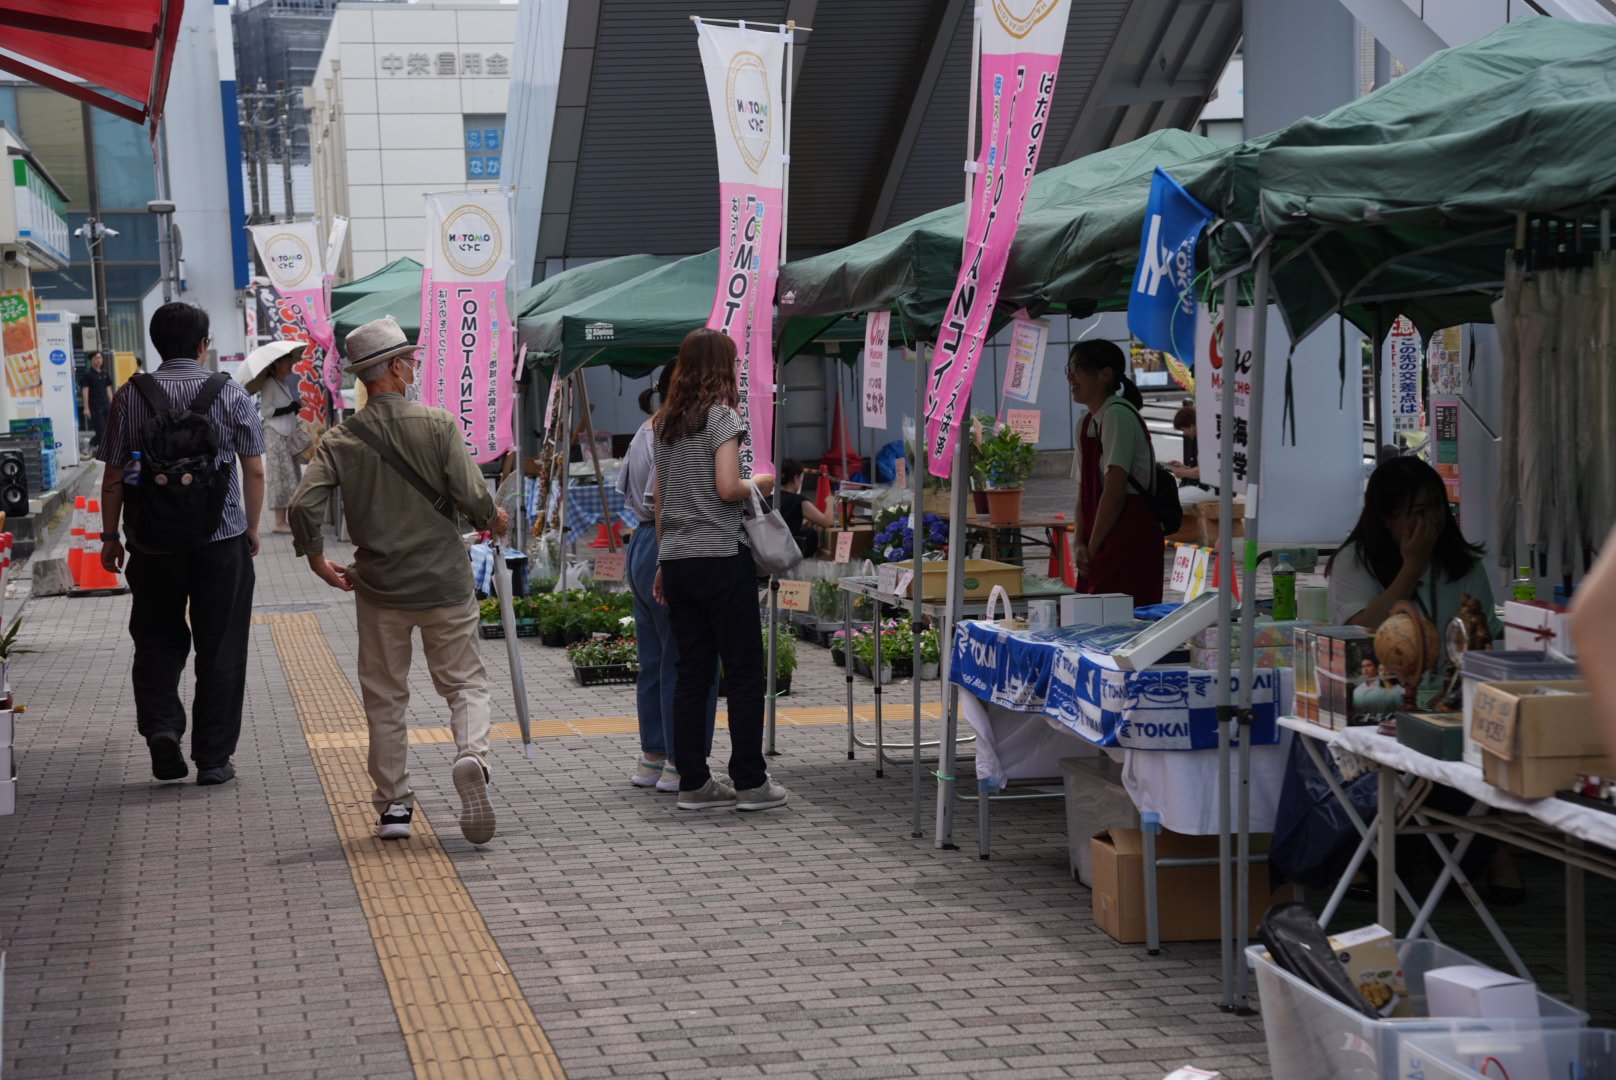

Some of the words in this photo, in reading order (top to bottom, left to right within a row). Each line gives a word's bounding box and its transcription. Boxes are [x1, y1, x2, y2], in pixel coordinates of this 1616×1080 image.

[381, 52, 509, 75] 中栄信用金
[470, 159, 500, 174] なか
[1400, 337, 1417, 414] この先の交差点は
[1215, 413, 1248, 448] 海
[1213, 674, 1272, 693] OAI
[1134, 722, 1190, 738] TOKAI
